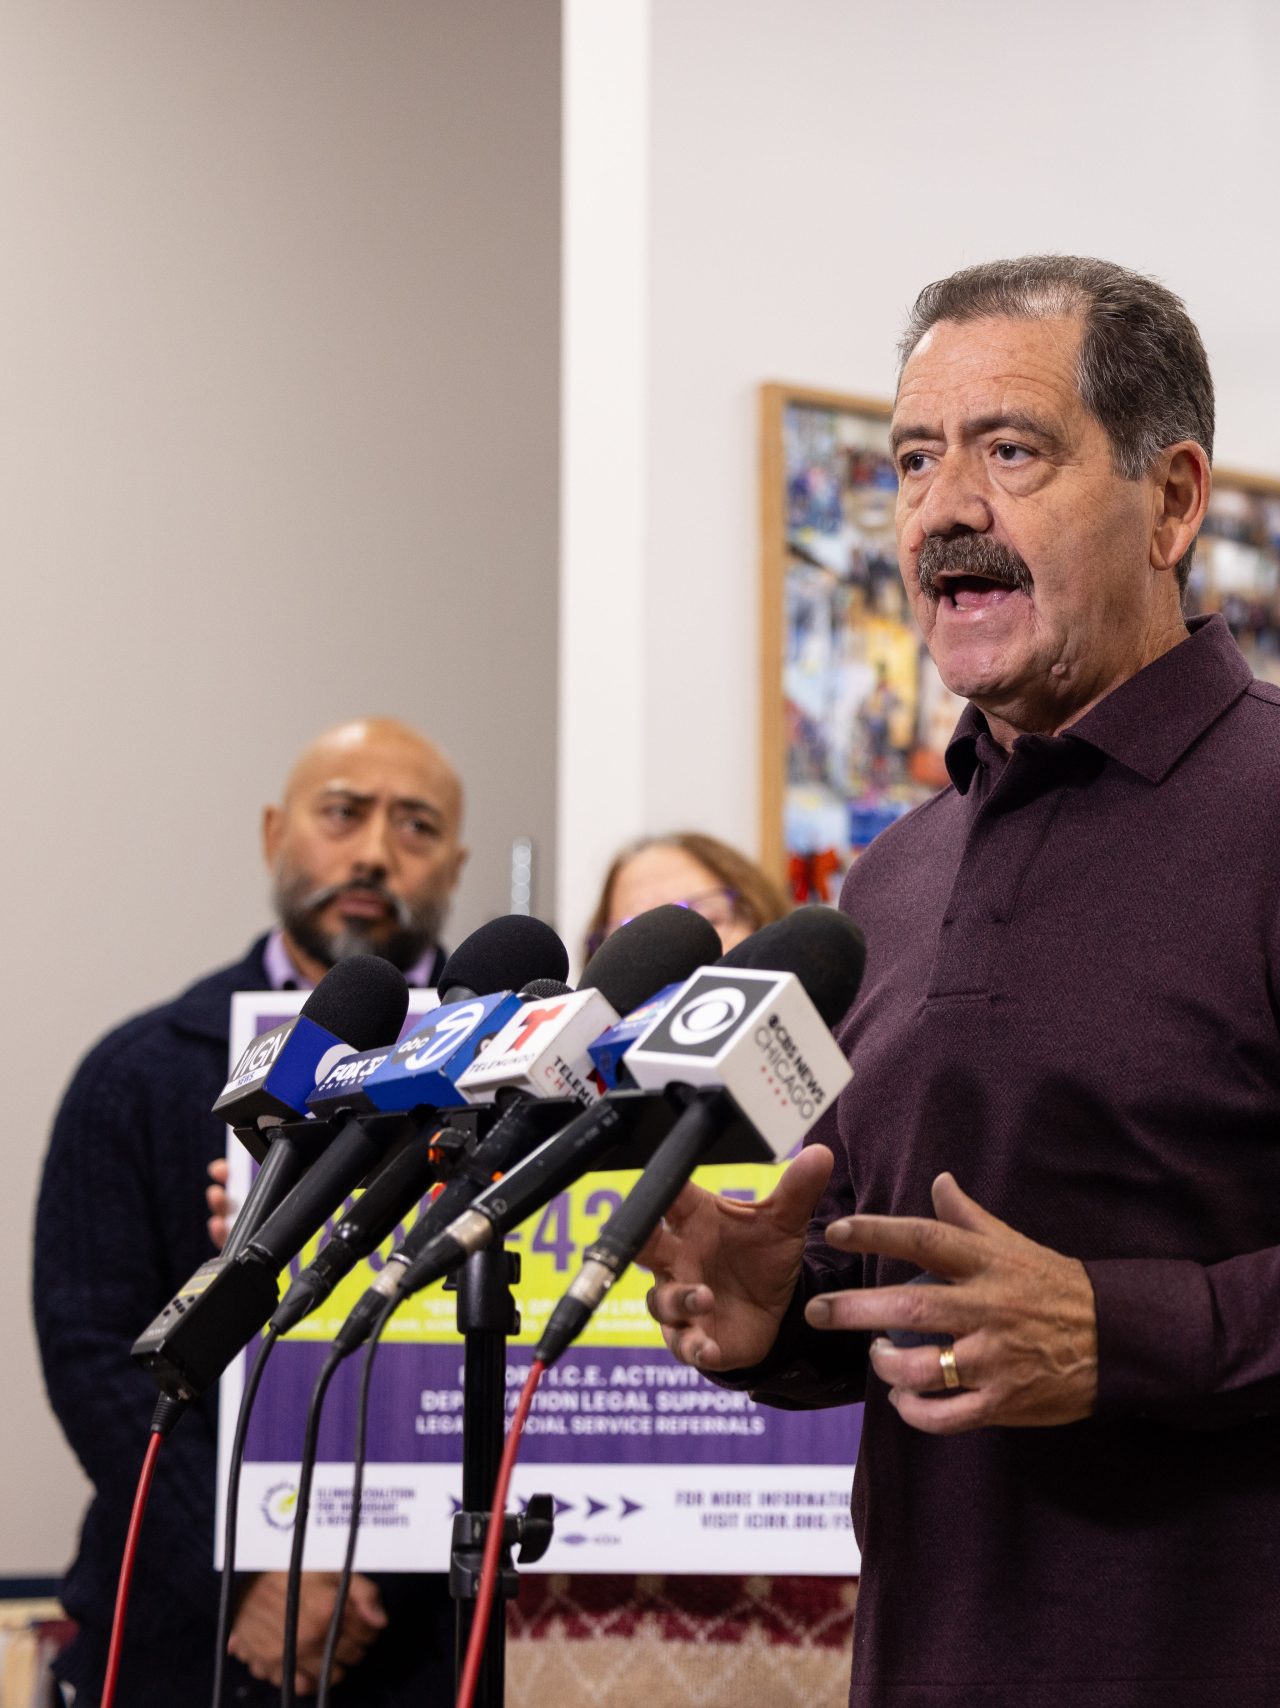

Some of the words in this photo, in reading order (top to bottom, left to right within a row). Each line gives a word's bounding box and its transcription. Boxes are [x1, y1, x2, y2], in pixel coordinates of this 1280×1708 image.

[232, 1028, 292, 1081] WGN
[398, 1035, 430, 1054] abc
[325, 1058, 370, 1084] FOX
[754, 1015, 816, 1120] CHICAGO
[775, 1025, 798, 1059] CBS
[794, 1055, 826, 1105] NEWS
[610, 1365, 713, 1387] ACTIVIT
[581, 1391, 653, 1413] LEGAL
[415, 1414, 465, 1435] LEGA
[570, 1416, 651, 1436] SERVICE
[655, 1416, 766, 1437] REFERRALS
